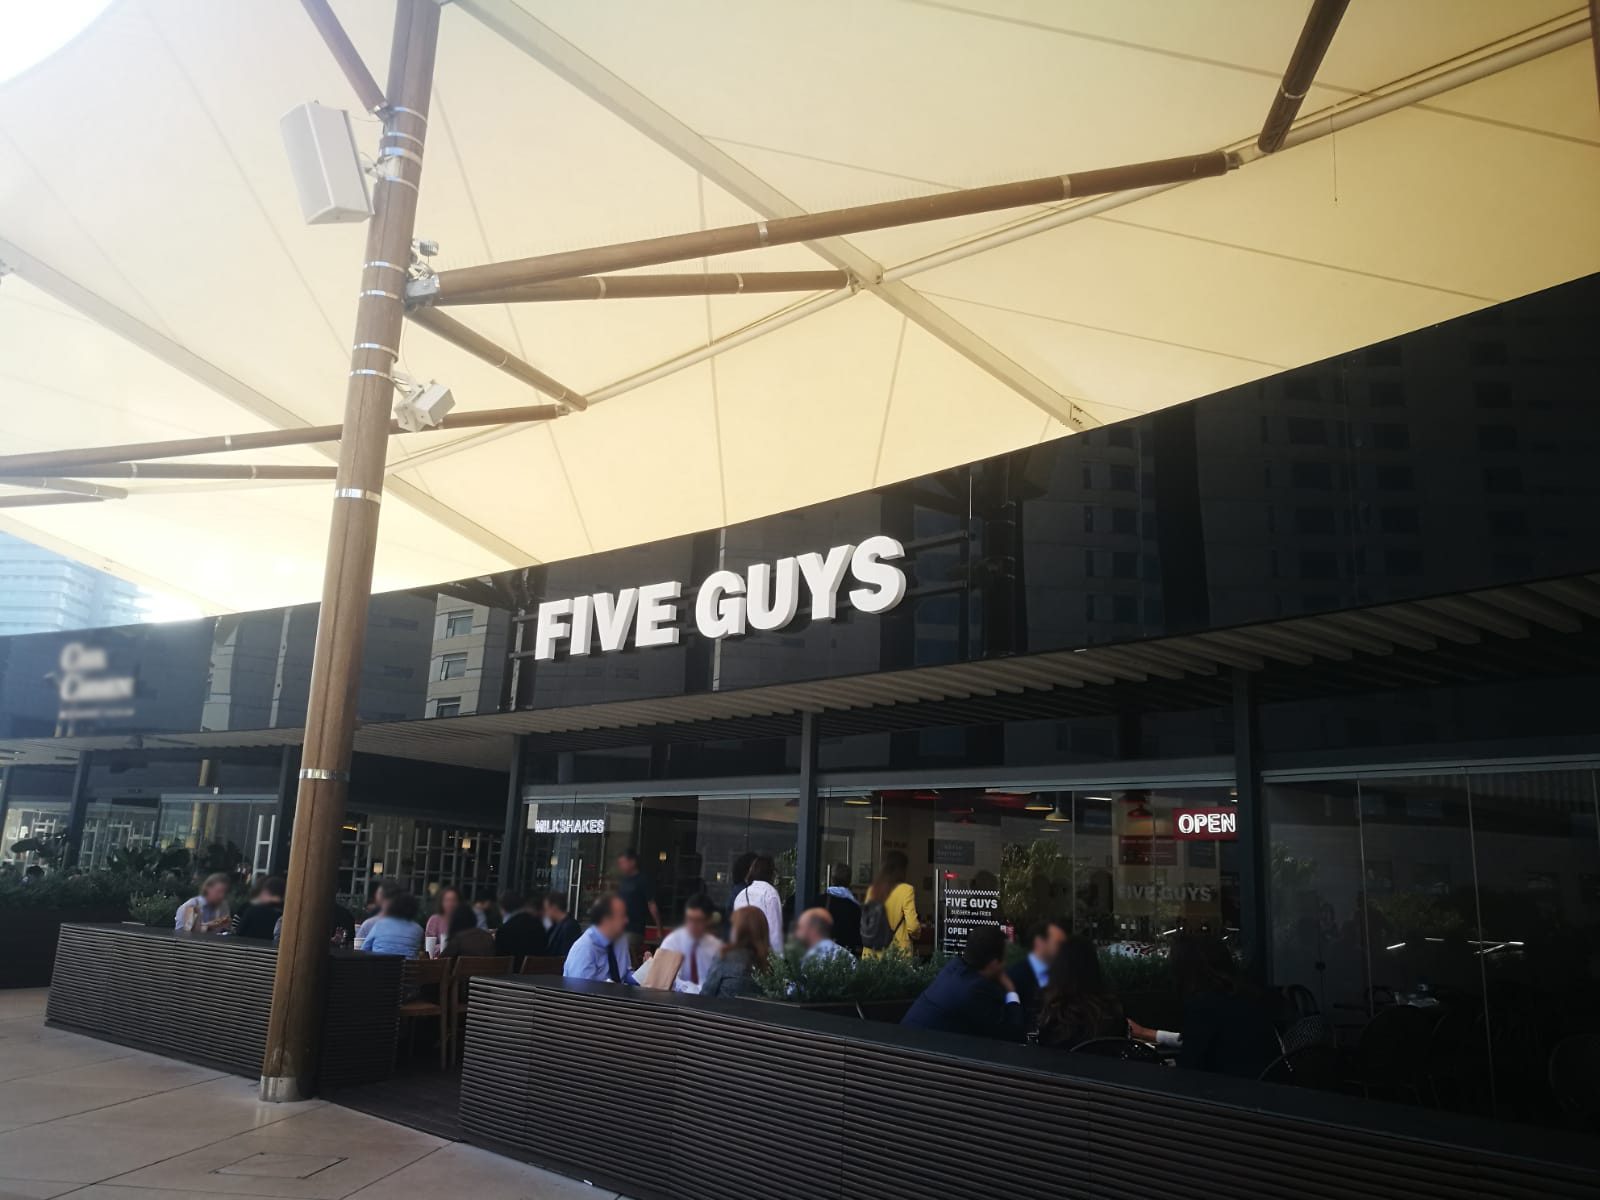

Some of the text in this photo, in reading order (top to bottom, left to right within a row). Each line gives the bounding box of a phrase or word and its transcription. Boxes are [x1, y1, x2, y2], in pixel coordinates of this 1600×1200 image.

[535, 535, 907, 660] FIVE GUYS
[535, 819, 605, 833] MILKSHAKES
[1178, 813, 1236, 834] OPEN
[1160, 886, 1213, 902] GUYS
[946, 897, 998, 909] FIVE GUYS
[948, 927, 968, 935] OPEN
